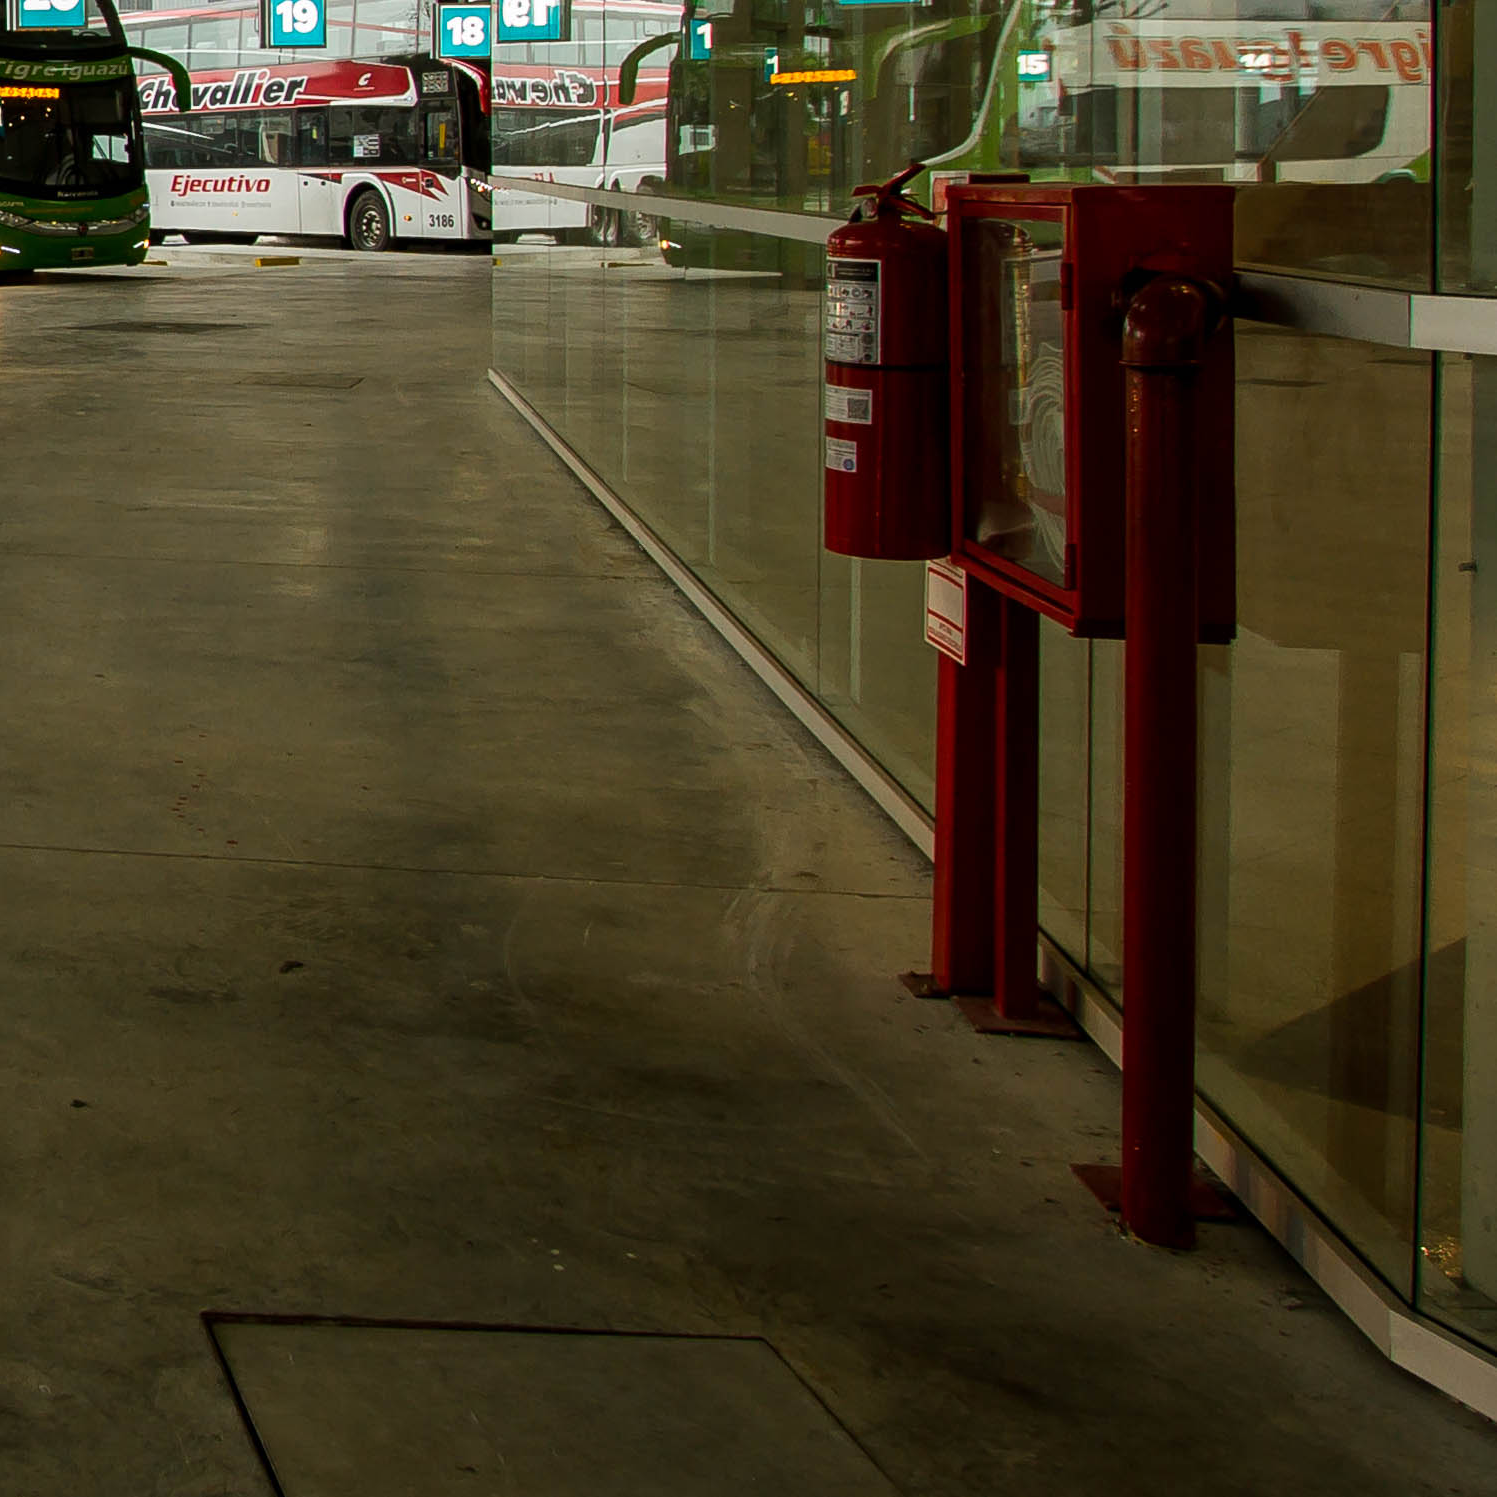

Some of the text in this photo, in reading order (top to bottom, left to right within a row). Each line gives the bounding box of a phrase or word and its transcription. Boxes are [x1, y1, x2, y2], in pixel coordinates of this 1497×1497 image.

[276, 0, 318, 34] 19
[445, 16, 485, 46] 18
[1017, 55, 1049, 73] 15
[138, 69, 308, 112] Chvallier
[170, 174, 271, 197] Ejecutivo
[429, 214, 455, 228] 3186
